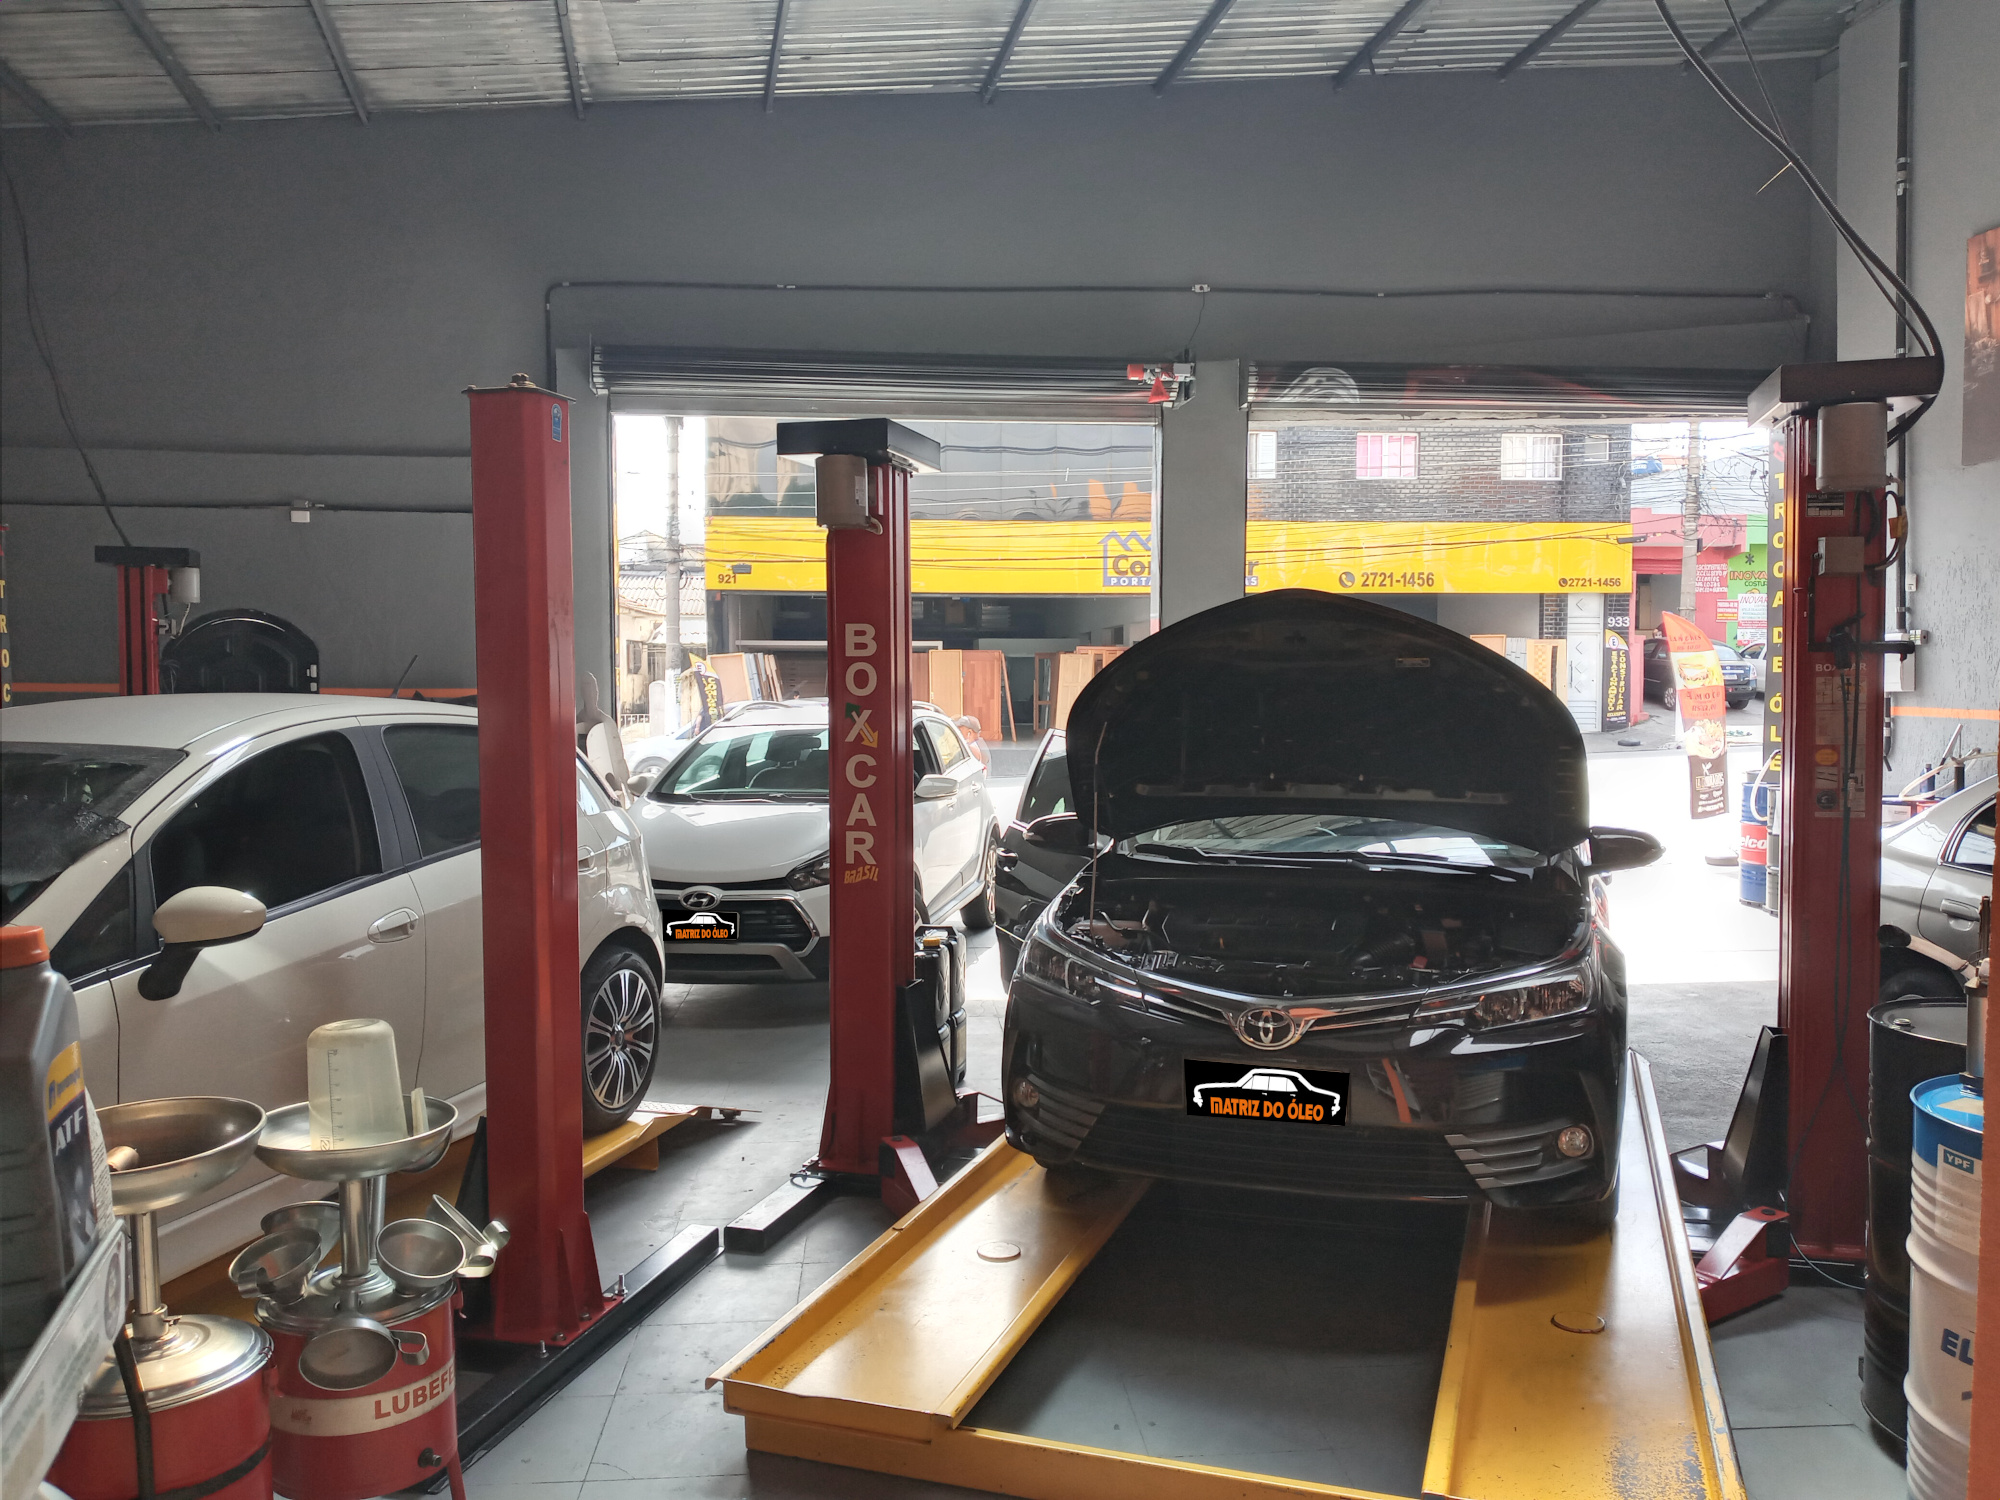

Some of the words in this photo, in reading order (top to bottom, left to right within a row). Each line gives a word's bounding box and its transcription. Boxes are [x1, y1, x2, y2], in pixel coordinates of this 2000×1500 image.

[718, 574, 736, 584] 921
[1361, 572, 1435, 587] 2721-1456
[1568, 578, 1621, 587] 2721-1456
[1608, 616, 1630, 627] 933
[55, 1105, 84, 1156] ATF
[1945, 1152, 1971, 1169] YPF
